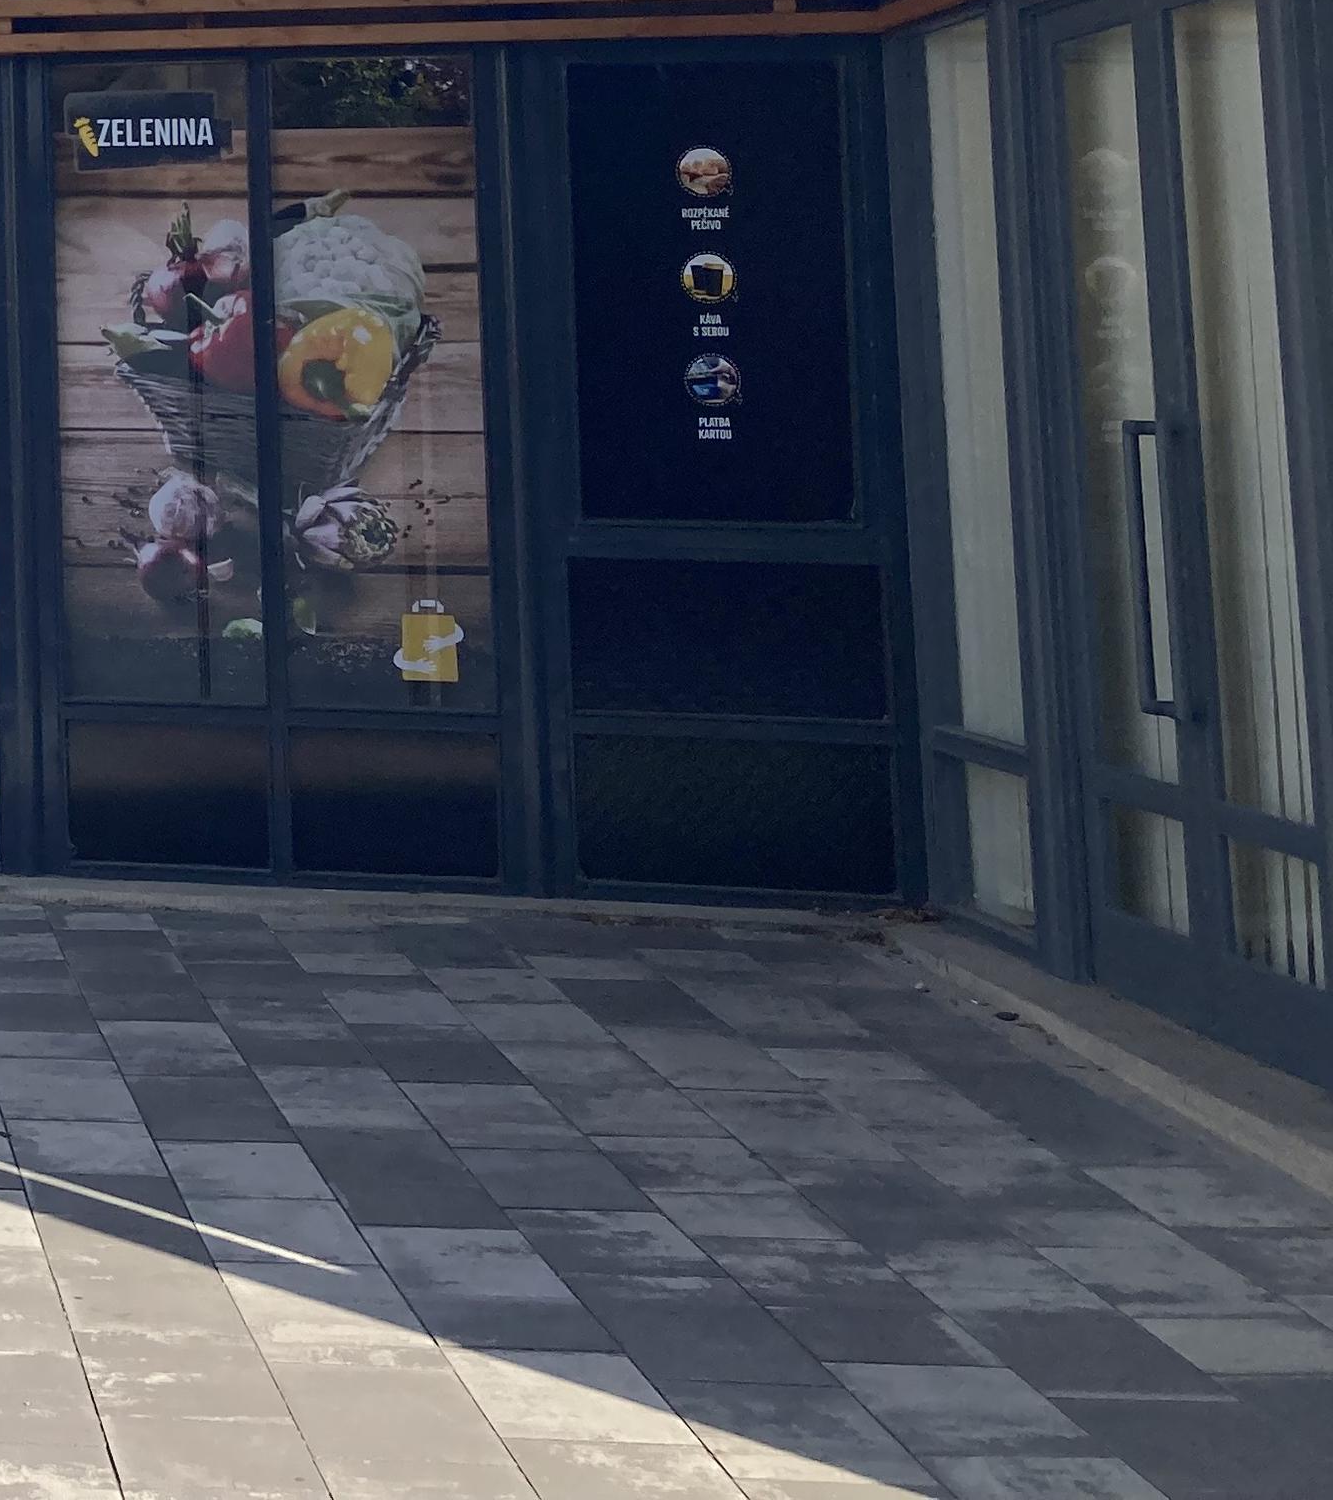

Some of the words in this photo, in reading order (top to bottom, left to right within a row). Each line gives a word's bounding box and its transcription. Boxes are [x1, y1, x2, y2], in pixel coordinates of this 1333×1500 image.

[96, 117, 214, 147] ZELENINA
[699, 312, 722, 325] KÁVA
[693, 326, 699, 337] S
[701, 326, 730, 337] SEBOU
[698, 417, 731, 428] PLATBA
[698, 429, 732, 440] KARTOU
